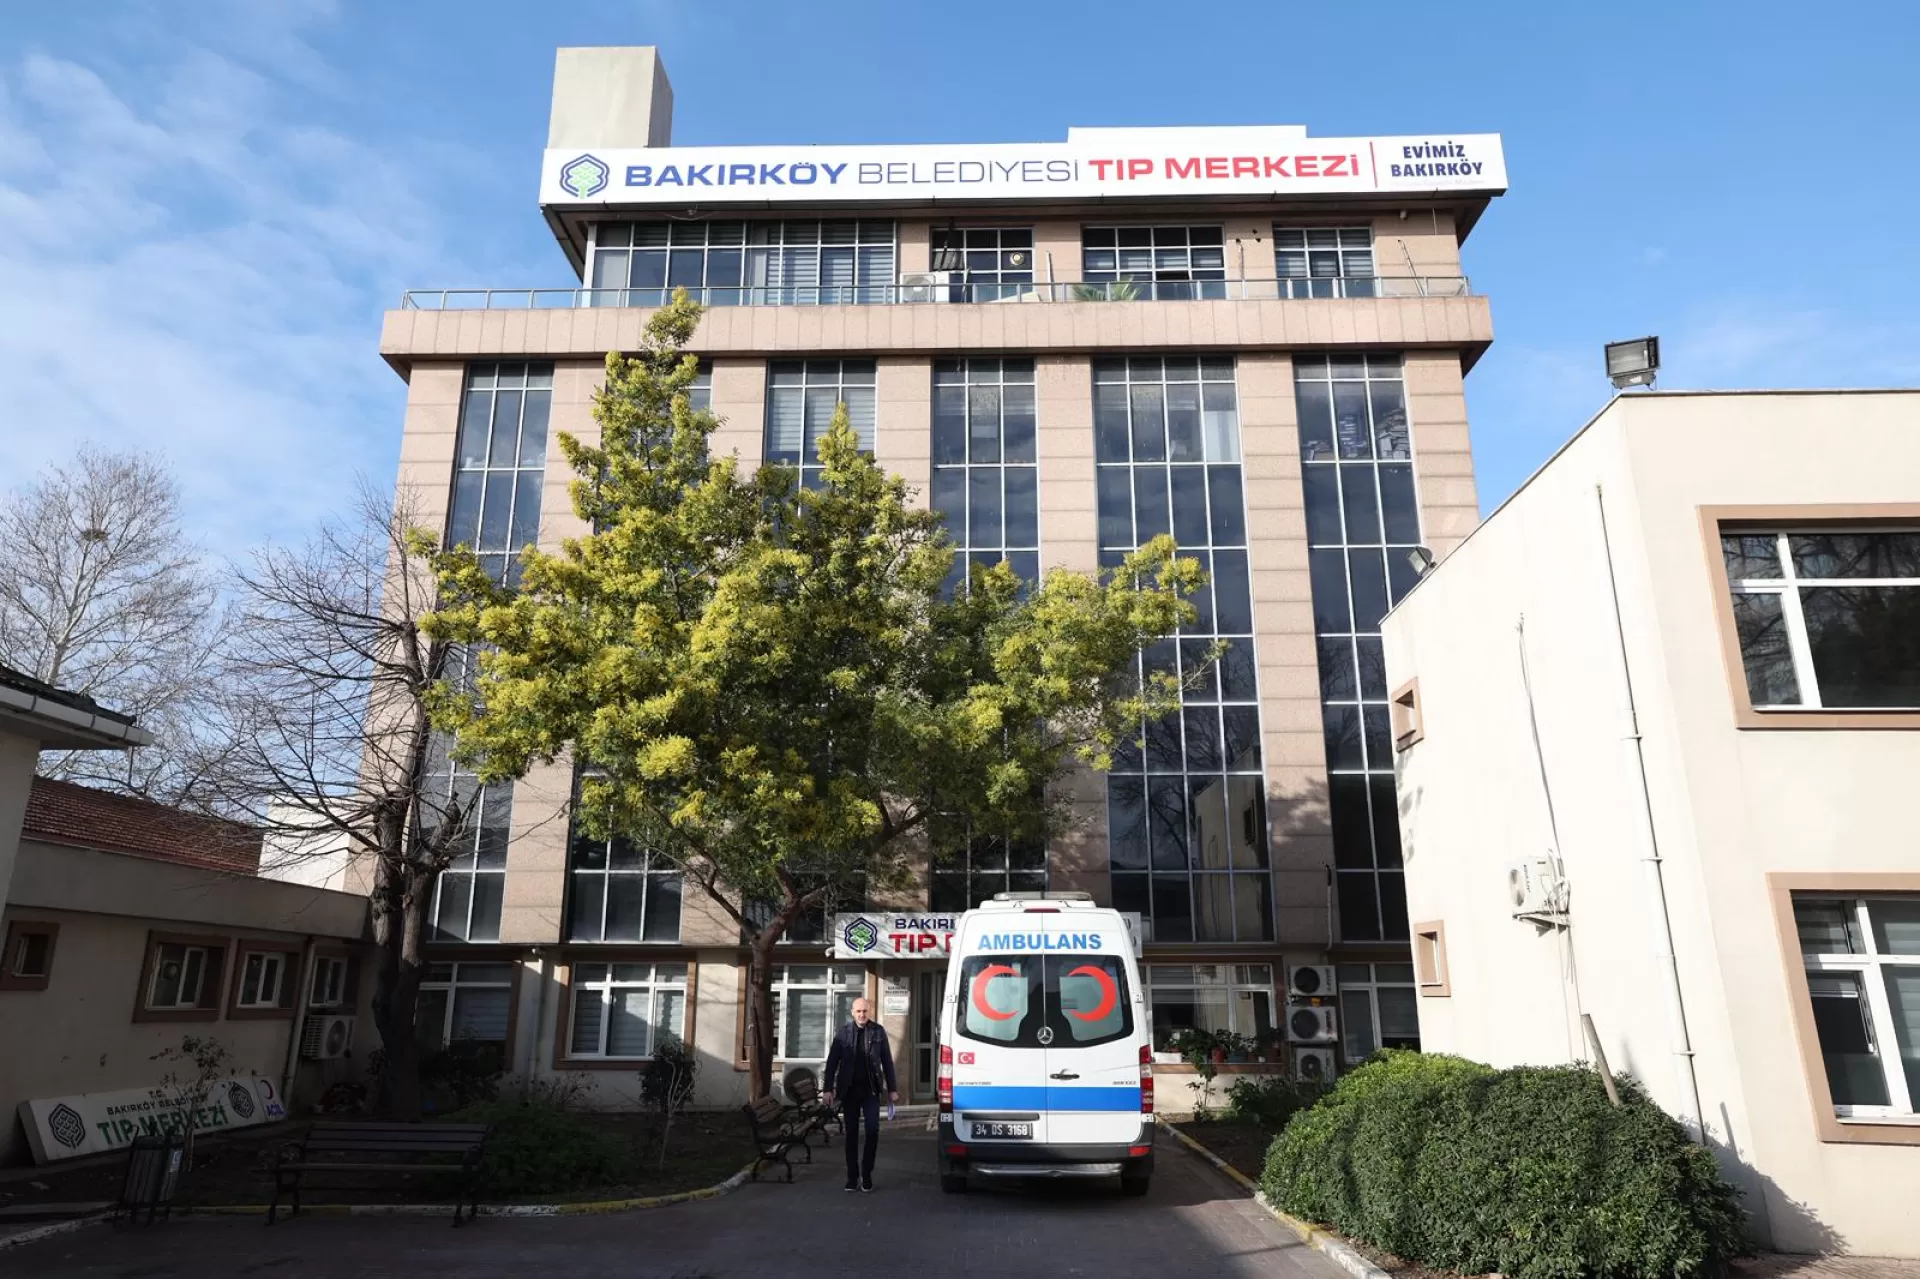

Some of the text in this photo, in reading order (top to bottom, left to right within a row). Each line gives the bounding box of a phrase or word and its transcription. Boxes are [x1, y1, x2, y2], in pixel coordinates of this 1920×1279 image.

[1403, 141, 1467, 159] EVİMİZ
[625, 153, 1360, 187] BAKIRKÖY BELEDİYESİ TIP MERKEZİ
[1390, 159, 1483, 177] BAKIRKÖY
[895, 918, 955, 930] BAKIR
[888, 933, 937, 953] TIP
[978, 933, 1103, 951] AMBULANS
[96, 1118, 134, 1145] TIP
[975, 1123, 988, 1136] 34
